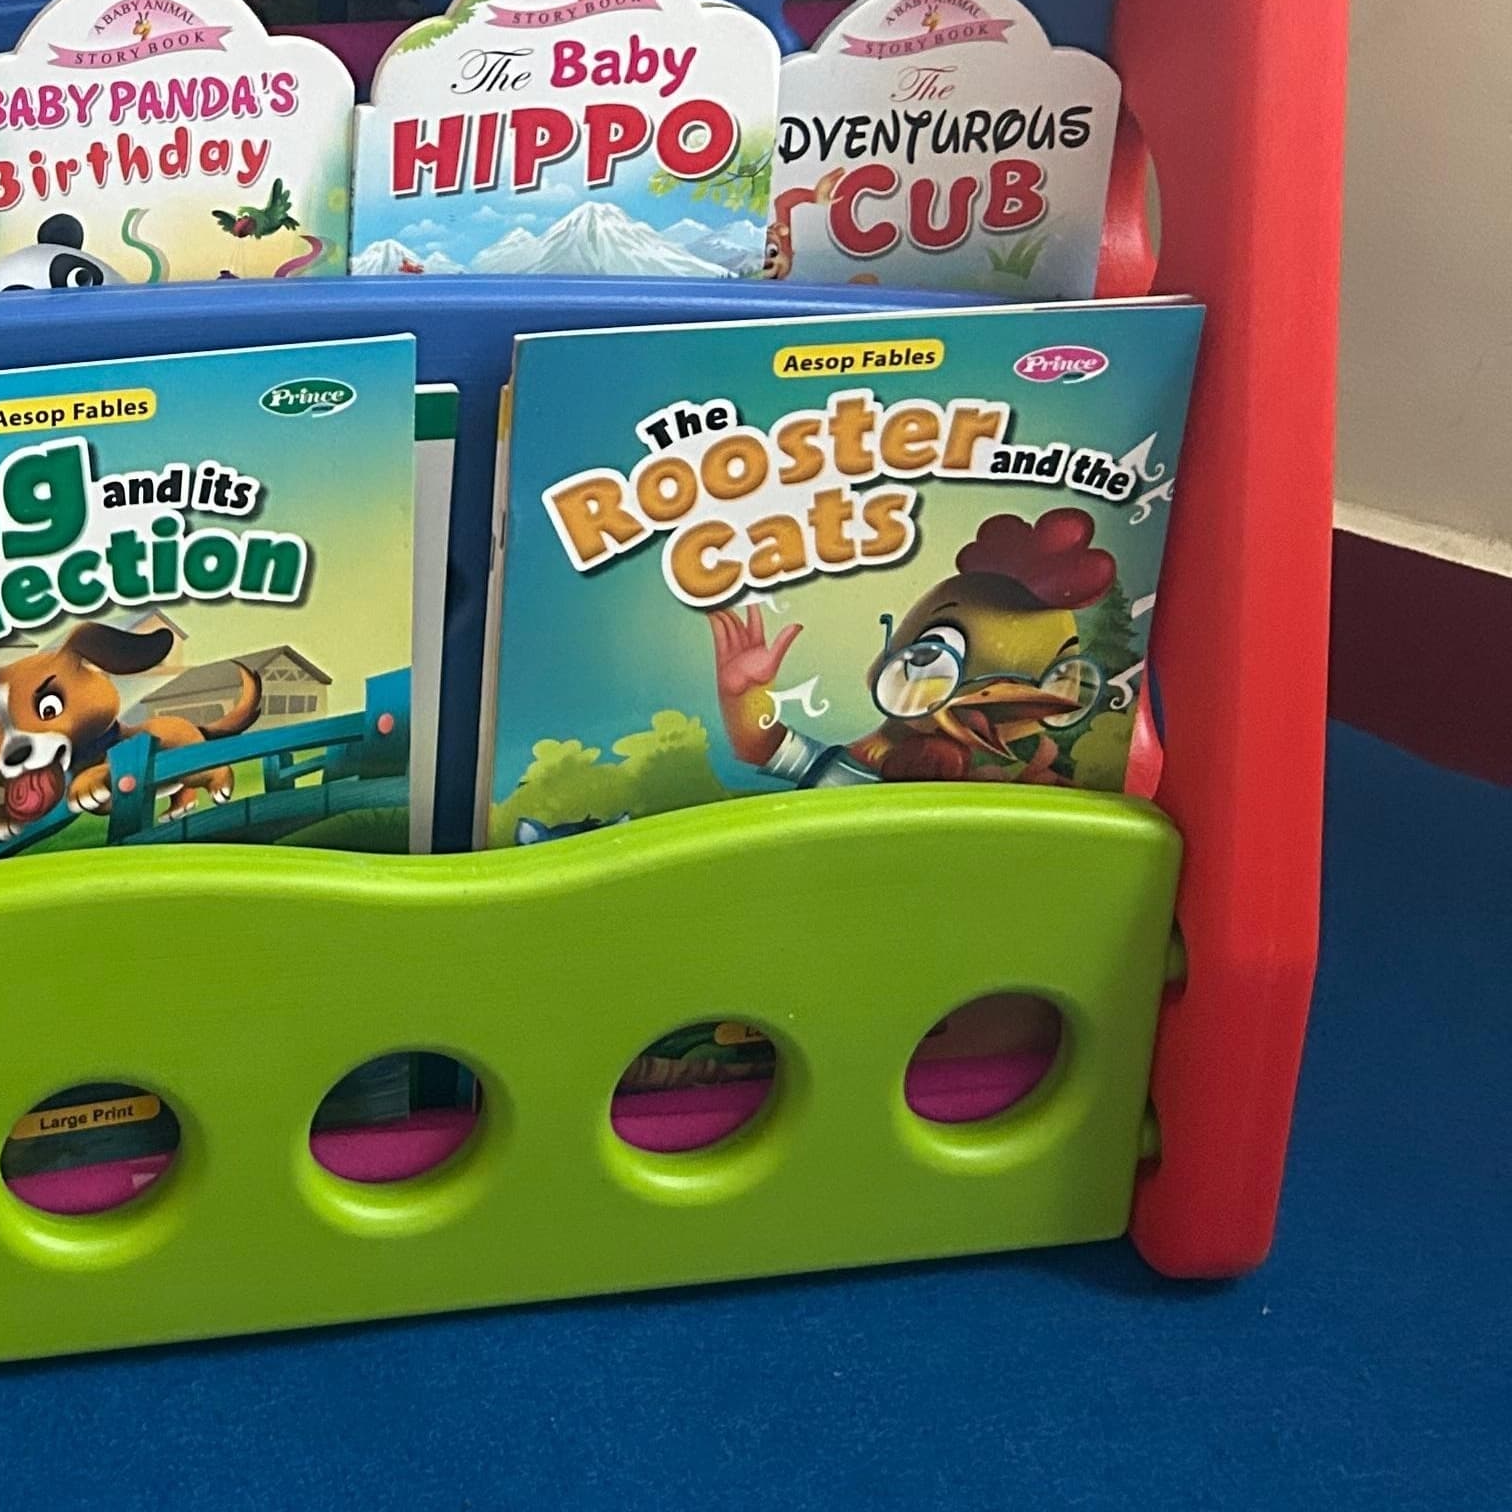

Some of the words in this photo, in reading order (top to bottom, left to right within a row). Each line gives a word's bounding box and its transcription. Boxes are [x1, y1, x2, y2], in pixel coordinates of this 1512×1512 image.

[101, 0, 139, 25] BABY
[144, 0, 194, 25] ANIMAL
[512, 7, 577, 25] STORY
[75, 48, 139, 65] STORY
[148, 31, 205, 54] BOOK
[864, 37, 926, 55] STORY
[934, 24, 989, 45] BOOK
[451, 47, 533, 96] The
[550, 34, 697, 99] Baby
[890, 65, 958, 103] The
[109, 72, 299, 122] PANDA'S
[392, 99, 738, 195] HIPPO
[778, 105, 1093, 164] DVENTUROUS
[829, 159, 1048, 256] CUB
[783, 349, 855, 372] Aesop
[861, 346, 937, 369] Fables
[1024, 352, 1099, 374] Prince
[72, 395, 149, 420] Fables
[269, 387, 345, 406] Prince
[646, 405, 728, 451] The
[103, 469, 183, 508] and
[199, 467, 253, 509] its
[550, 397, 1003, 562] Rooster
[990, 448, 1059, 478] and
[1073, 454, 1129, 494] the
[39, 1112, 88, 1130] Large
[93, 1105, 134, 1122] Print
